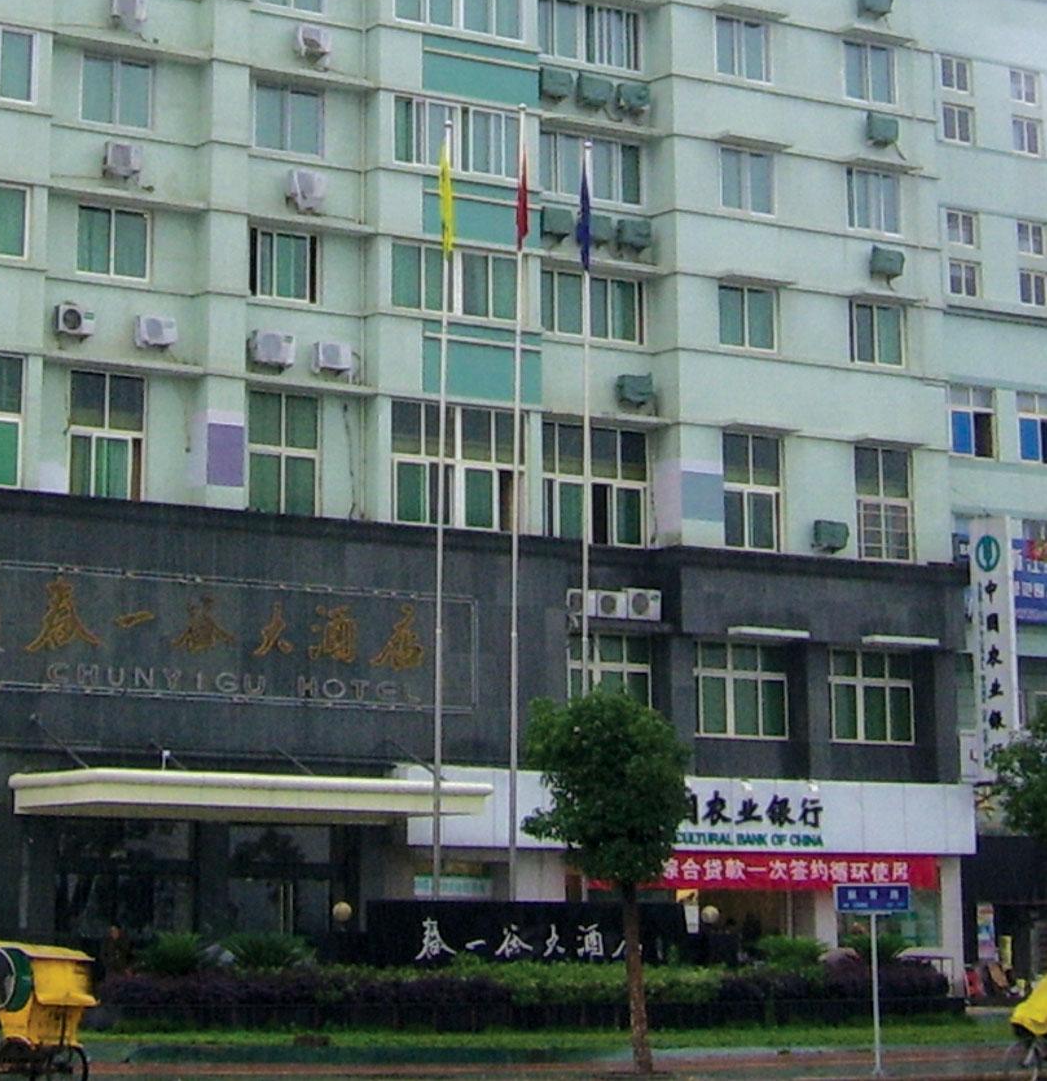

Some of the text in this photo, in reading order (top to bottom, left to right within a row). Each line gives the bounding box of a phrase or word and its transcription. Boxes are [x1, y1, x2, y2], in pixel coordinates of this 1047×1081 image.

[24, 576, 426, 670] 春一谷大酒店
[46, 661, 421, 703] CHUNYIGU HOTEL
[686, 790, 824, 828] 农业银行
[675, 832, 824, 847] CULTURAL BANK OF CHINA
